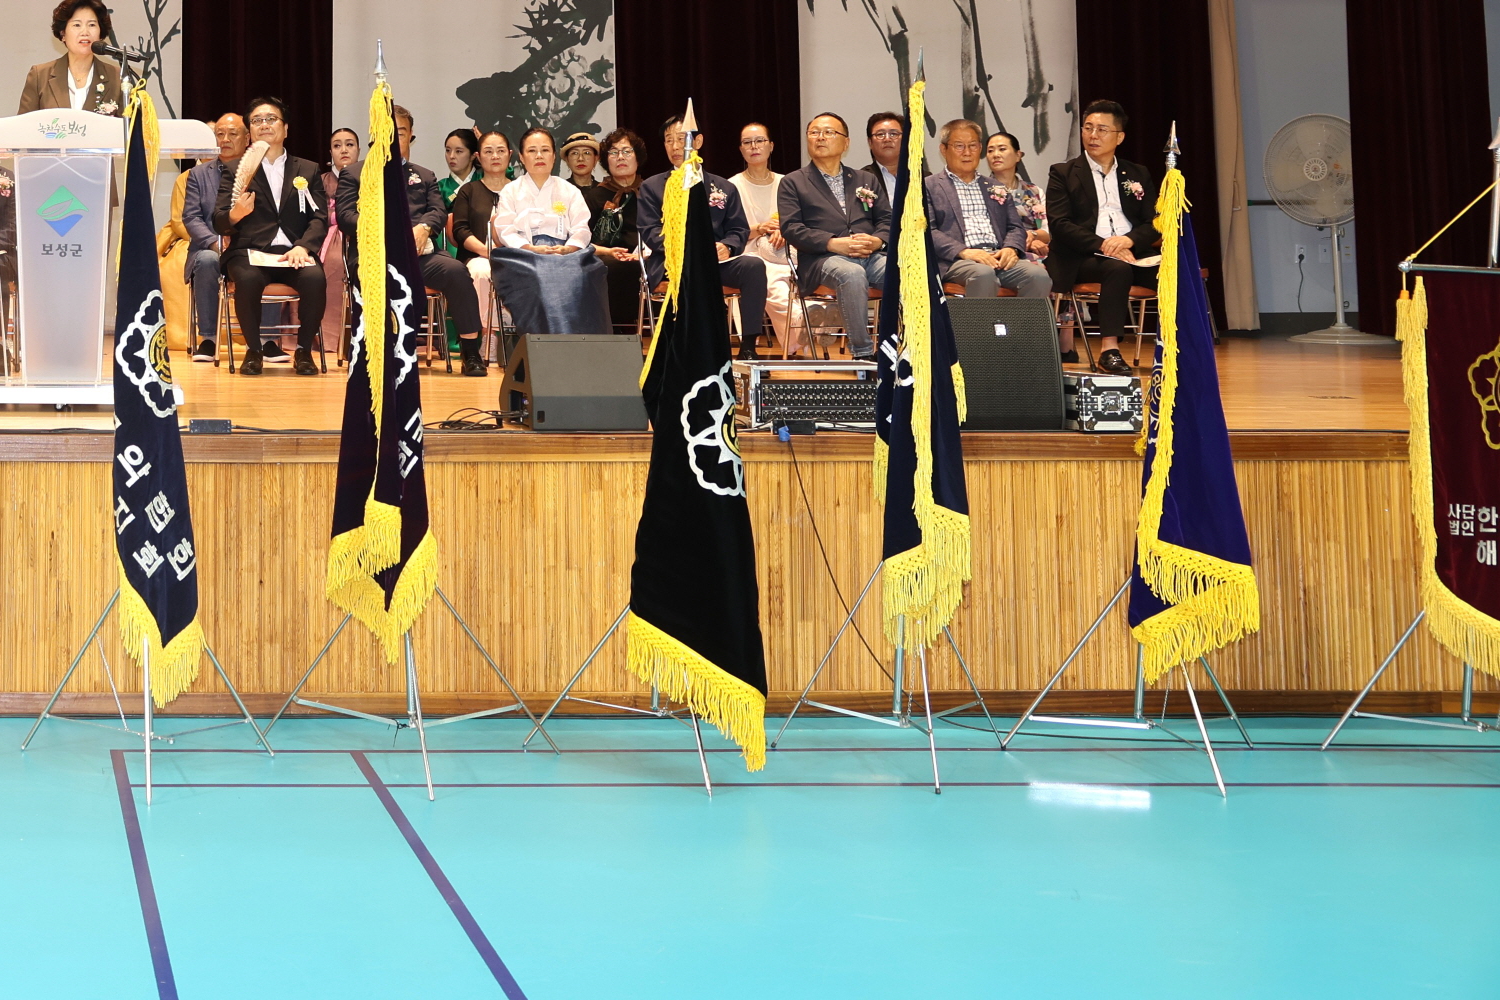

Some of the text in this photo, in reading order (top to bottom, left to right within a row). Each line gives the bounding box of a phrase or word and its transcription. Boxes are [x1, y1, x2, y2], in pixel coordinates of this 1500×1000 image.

[40, 242, 84, 258] 보성군
[1448, 504, 1475, 519] 사단
[1450, 521, 1474, 536] 법인
[1477, 540, 1496, 565] 해
